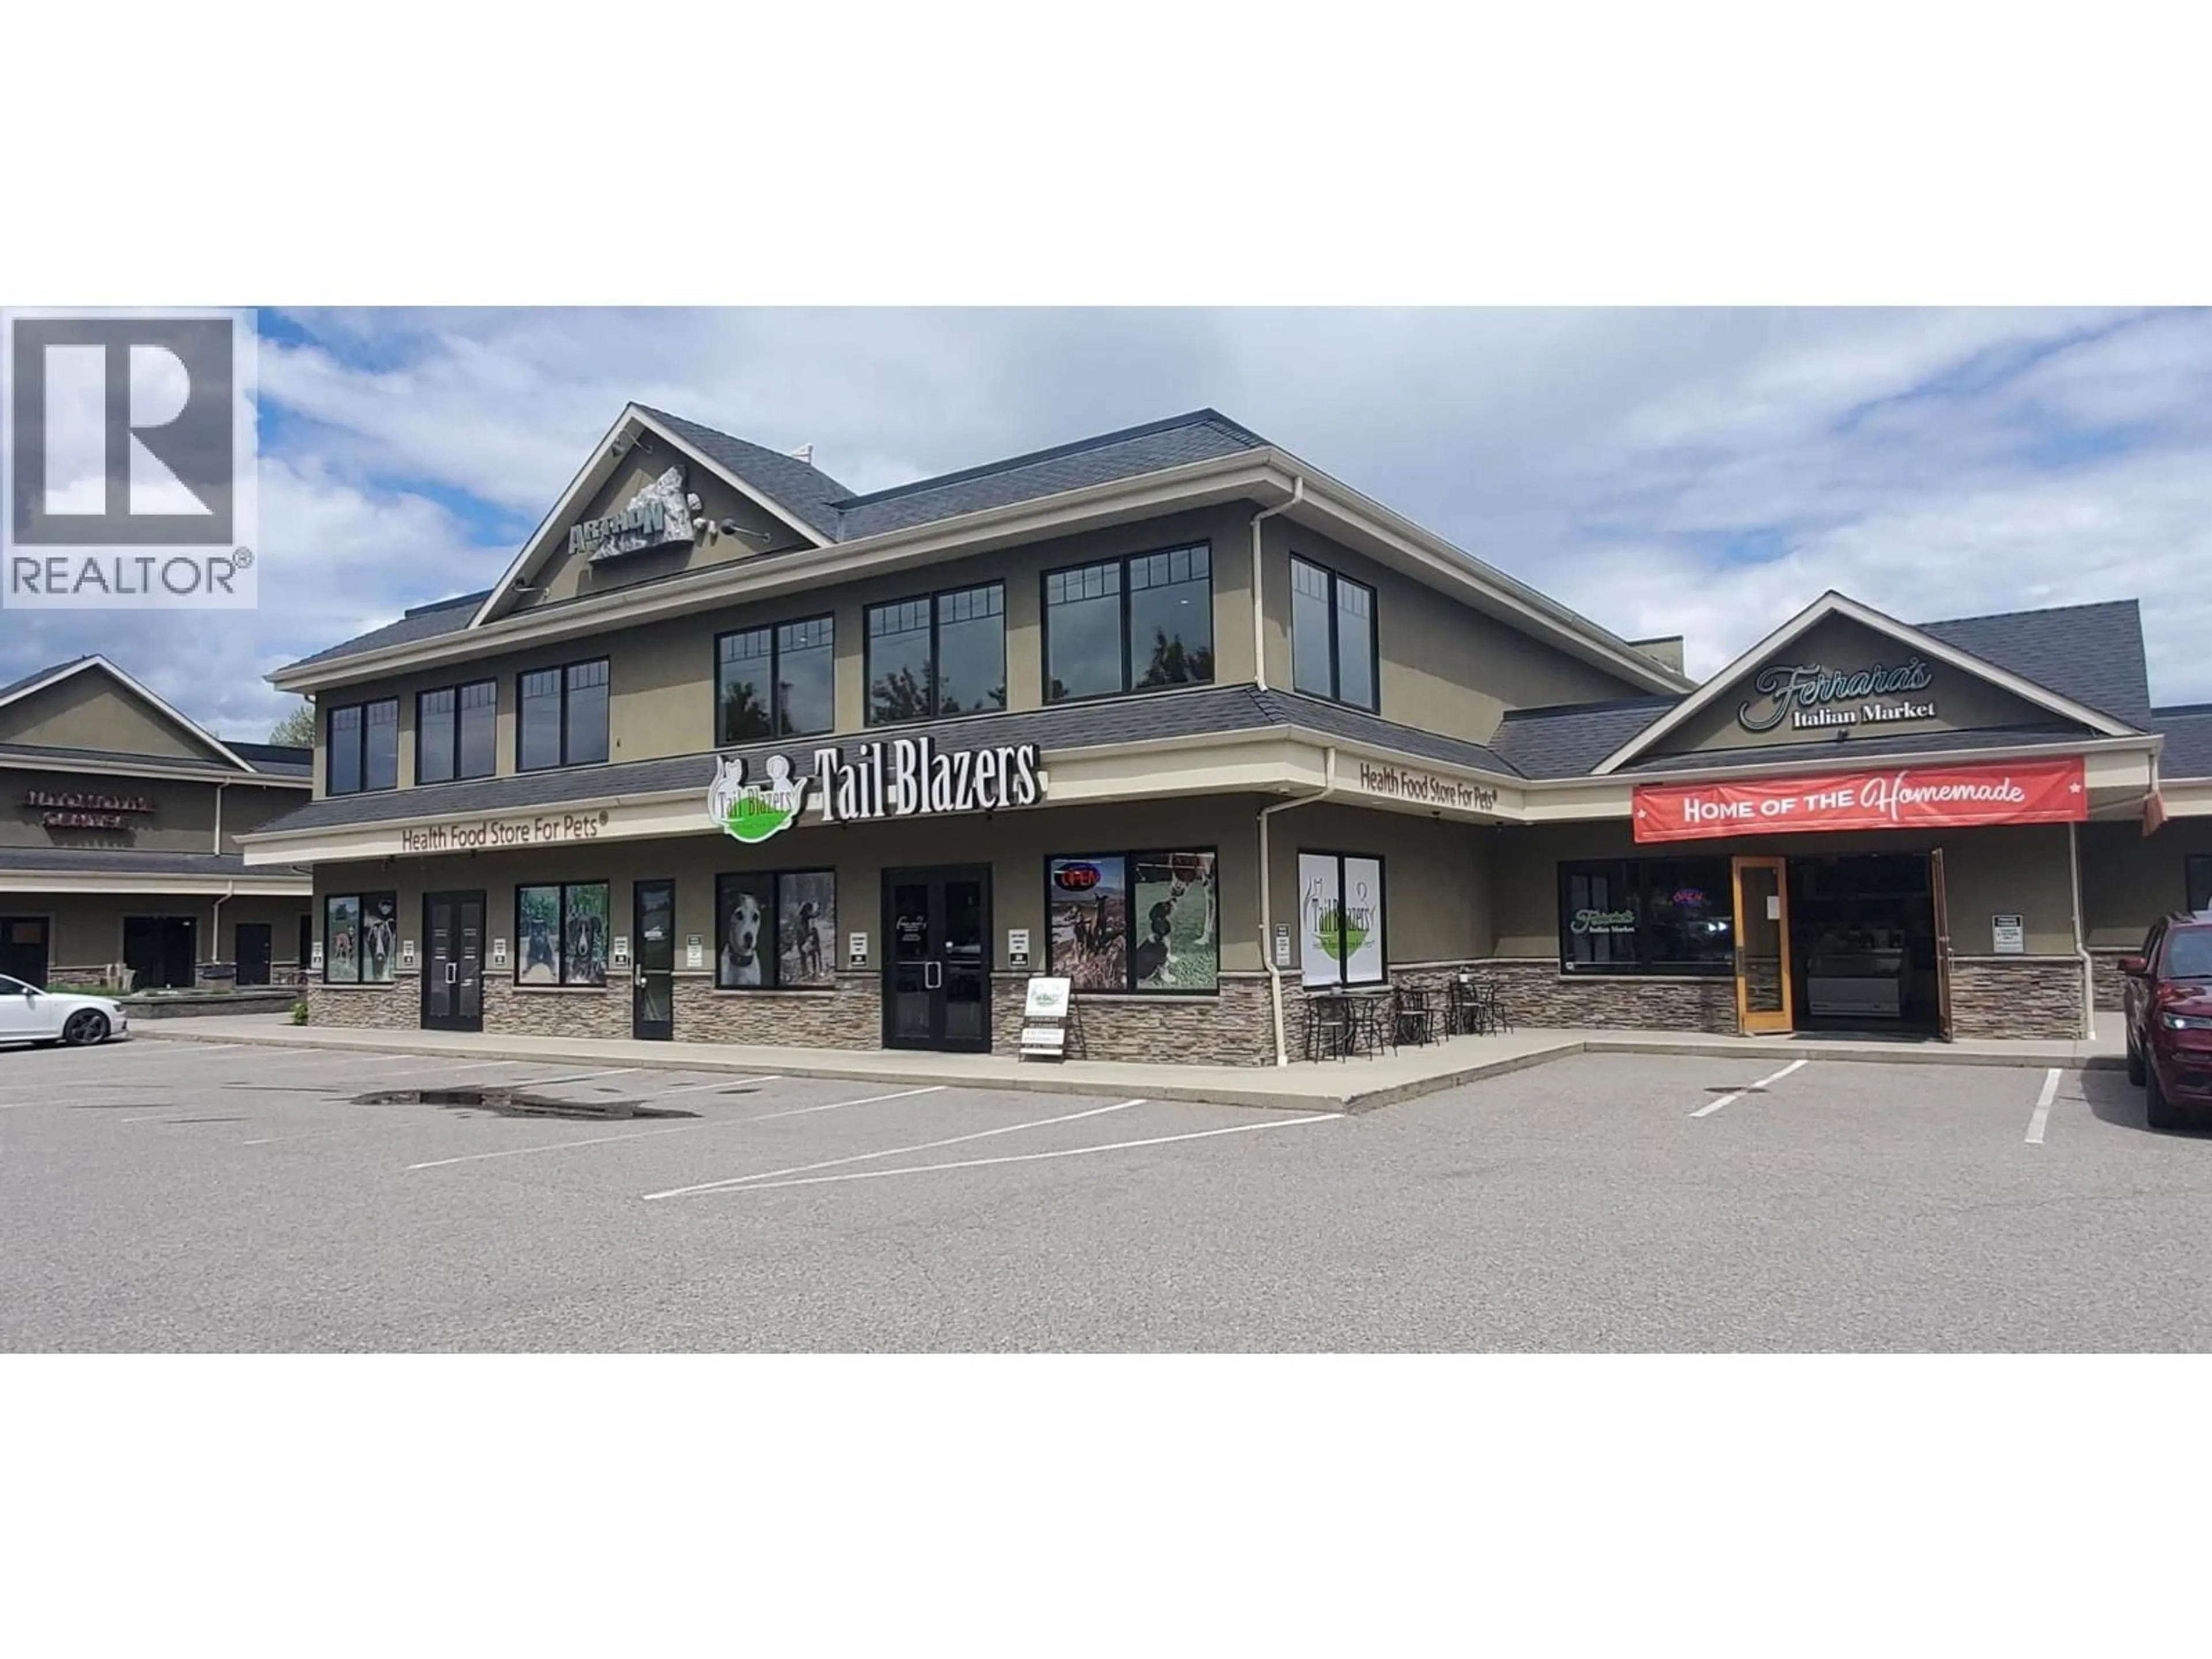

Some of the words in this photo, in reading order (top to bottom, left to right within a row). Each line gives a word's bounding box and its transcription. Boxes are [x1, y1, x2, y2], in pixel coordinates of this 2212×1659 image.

[568, 502, 664, 554] ARTHON
[1739, 657, 1931, 730] Ferrara's
[1793, 709, 1856, 728] Italian
[1862, 702, 1936, 721] Market
[814, 742, 886, 821] Tail
[893, 736, 1036, 815] Blazers
[1360, 762, 1399, 796] Health
[1401, 771, 1428, 800] Food
[1430, 777, 1456, 805] Store
[1457, 782, 1473, 806] For
[1684, 797, 1753, 823] HOME
[1760, 798, 1796, 815] OF
[1803, 789, 1854, 808] THE
[1859, 771, 2025, 820] Homemade
[718, 790, 743, 819] Tail
[747, 787, 793, 816] Blazers
[403, 826, 446, 851] Health
[450, 821, 486, 847] Food
[491, 821, 530, 844] Store
[535, 817, 560, 840] For
[1312, 898, 1331, 933] Tail
